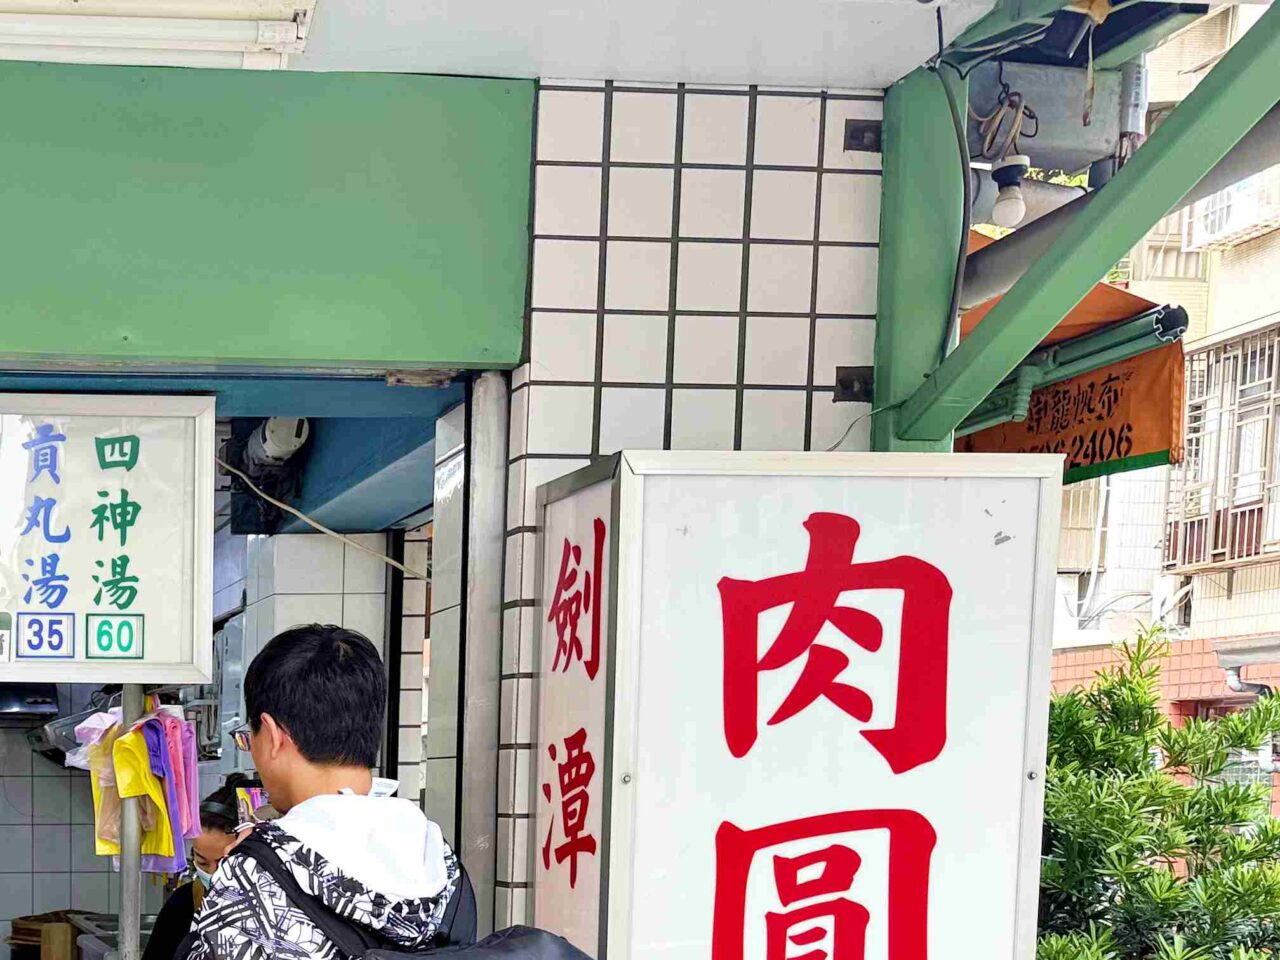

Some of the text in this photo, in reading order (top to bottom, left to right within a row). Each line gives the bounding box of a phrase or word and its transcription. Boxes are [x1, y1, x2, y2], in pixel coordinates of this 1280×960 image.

[21, 424, 70, 609] 貢丸湯
[90, 434, 141, 610] 四神湯
[26, 617, 63, 650] 35
[98, 620, 134, 652] 60
